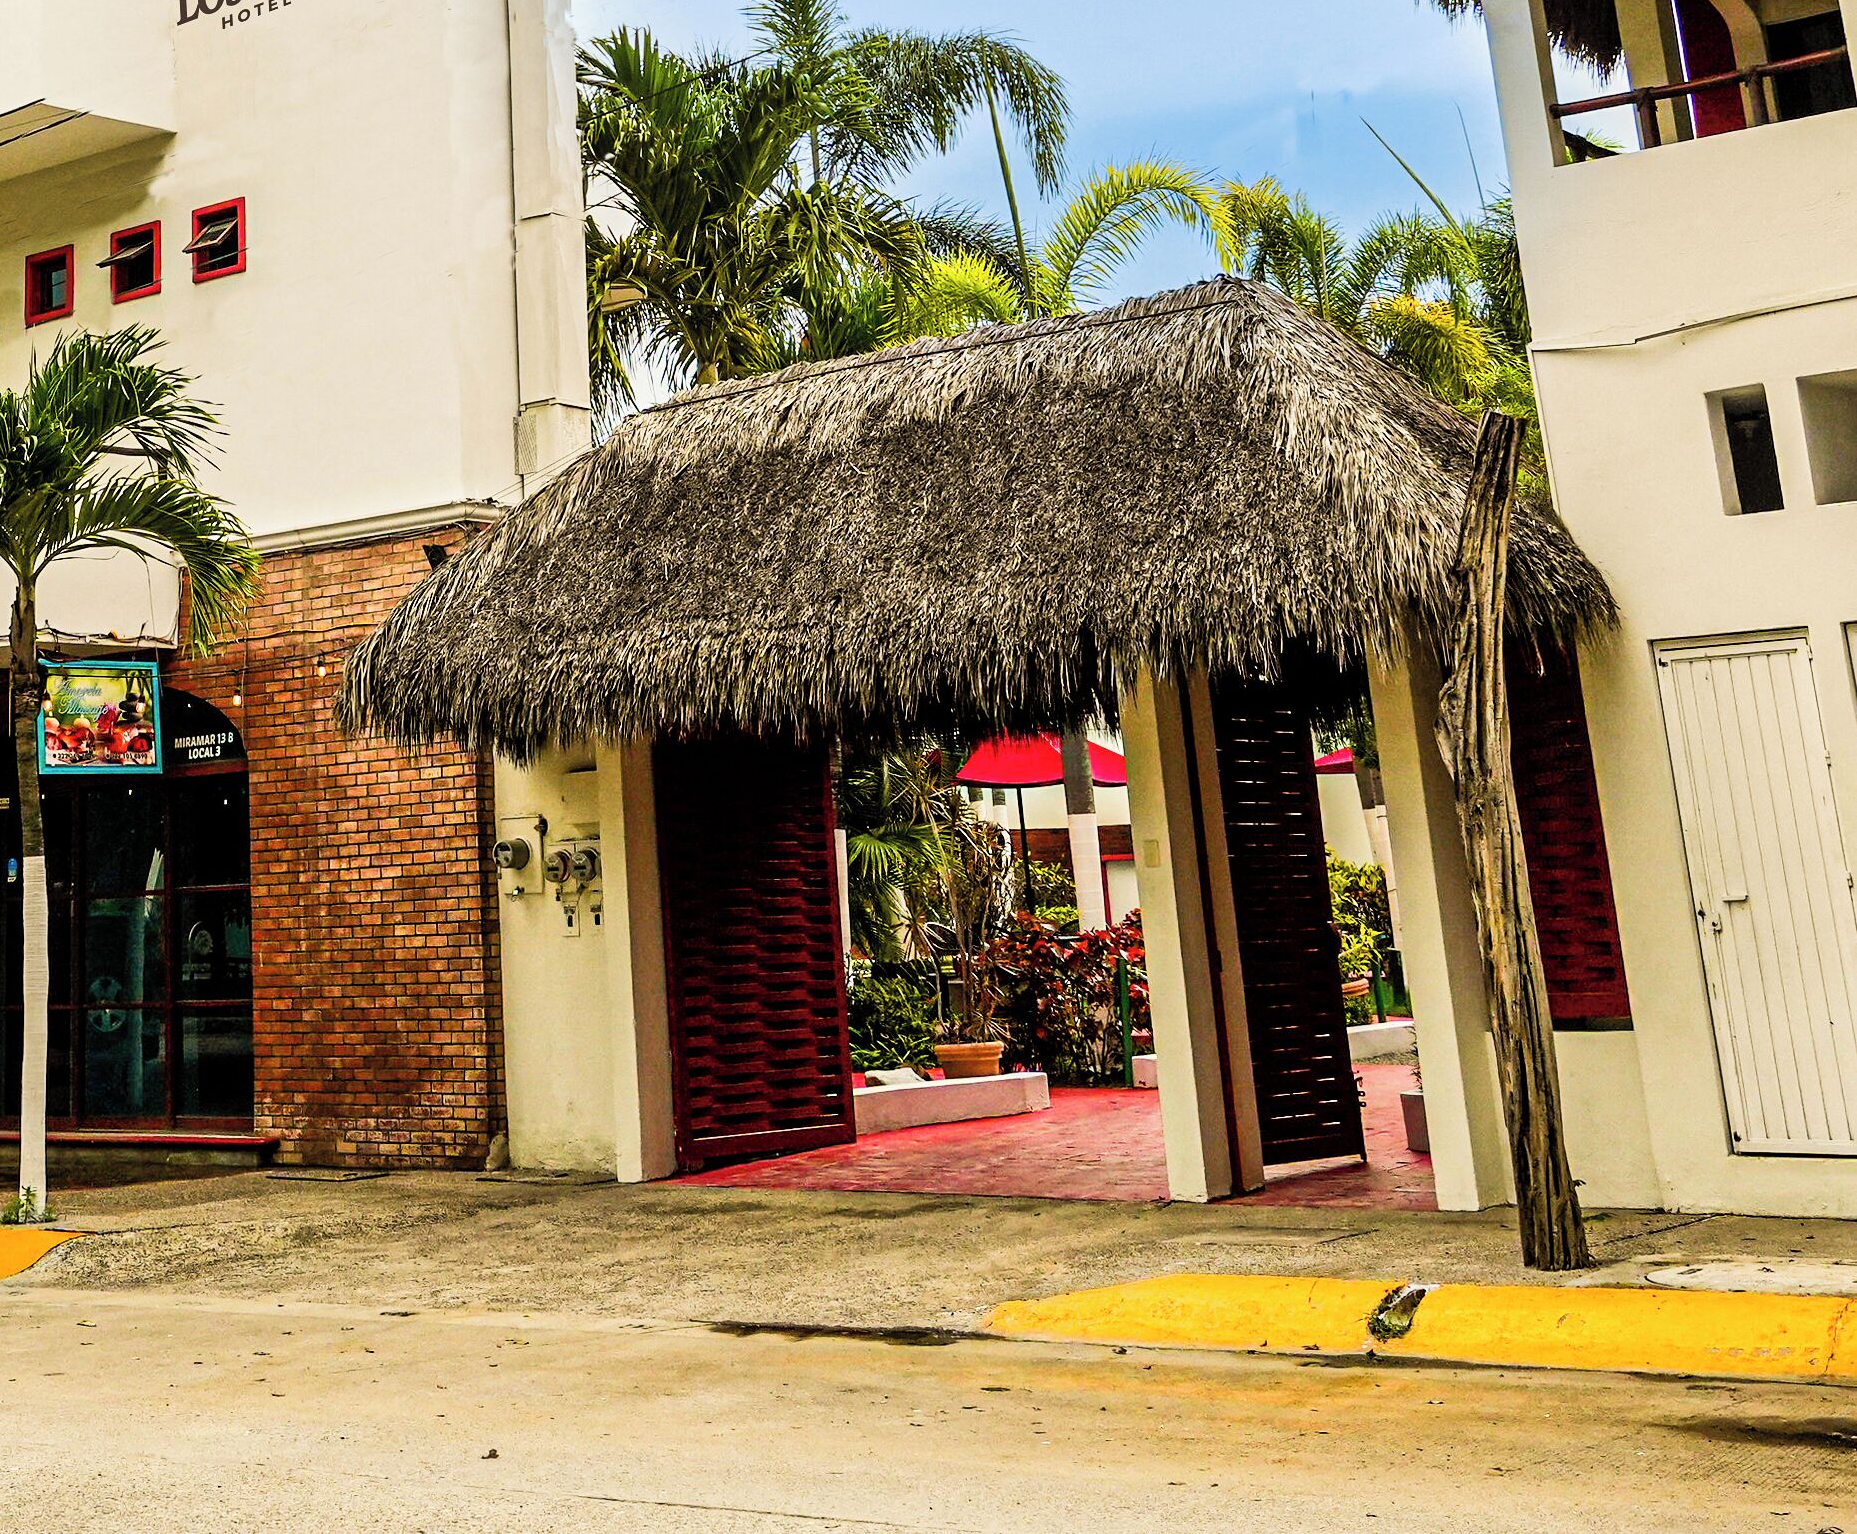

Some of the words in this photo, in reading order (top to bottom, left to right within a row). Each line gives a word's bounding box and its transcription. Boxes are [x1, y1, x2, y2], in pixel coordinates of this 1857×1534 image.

[174, 734, 216, 749] MIRAMAR
[217, 732, 226, 744] 13
[188, 747, 215, 760] LOCAL
[215, 746, 221, 757] 3
